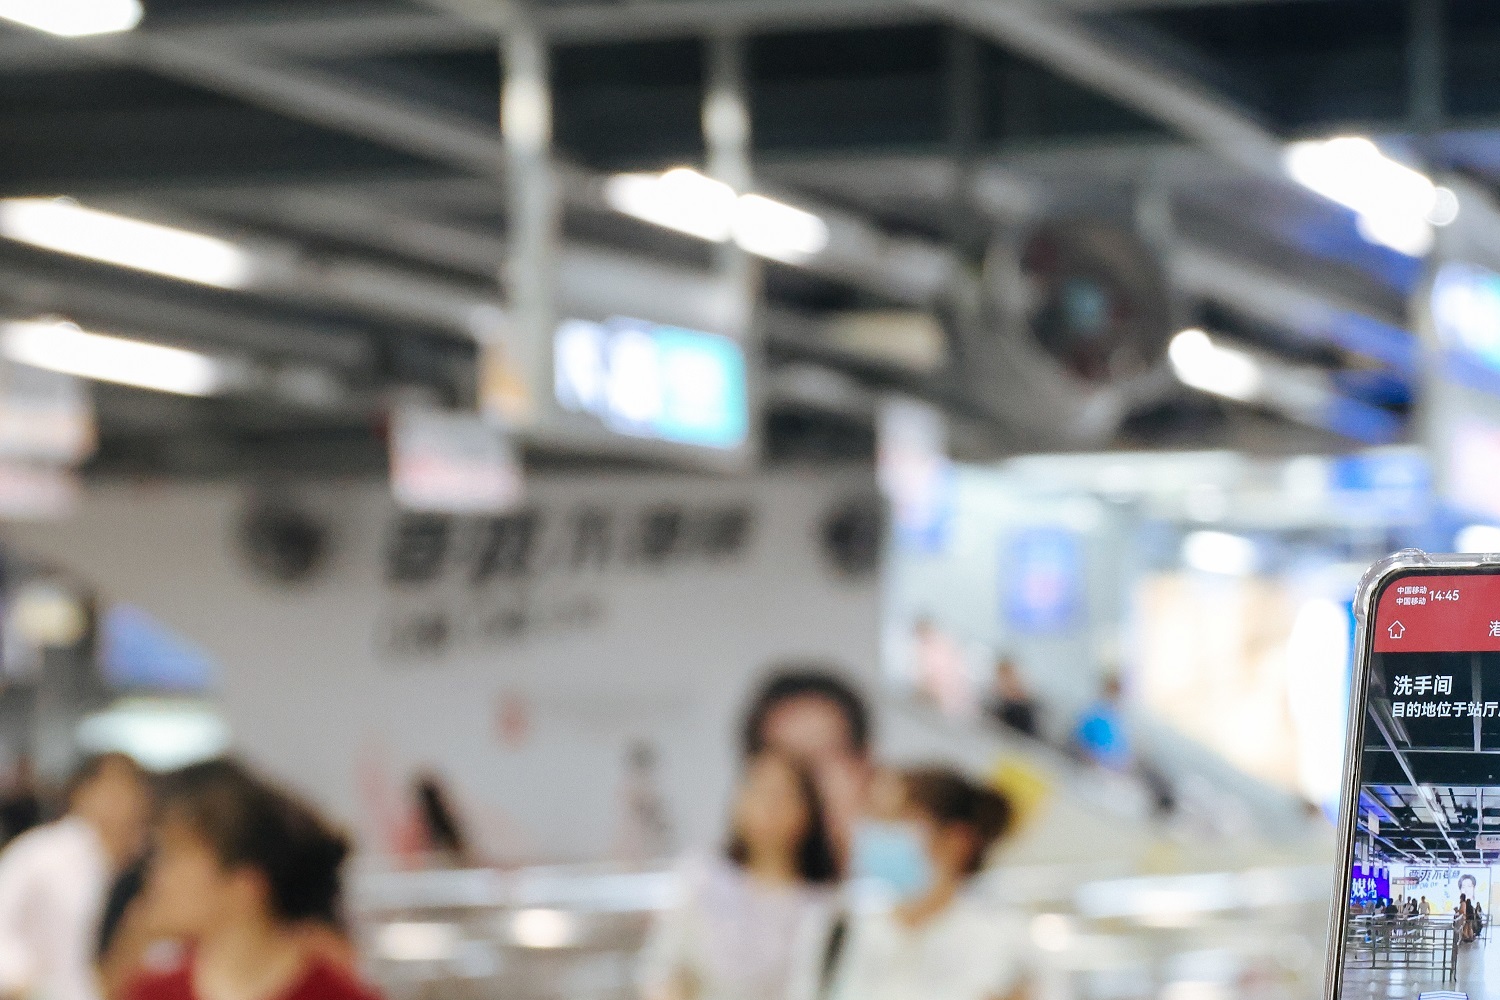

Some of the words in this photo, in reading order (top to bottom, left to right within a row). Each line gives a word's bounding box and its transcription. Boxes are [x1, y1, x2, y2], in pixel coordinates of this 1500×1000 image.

[1396, 586, 1428, 595] 中国移动
[1428, 589, 1460, 602] 14:45
[1396, 597, 1427, 606] 中国移动
[1392, 674, 1453, 696] 洗手间
